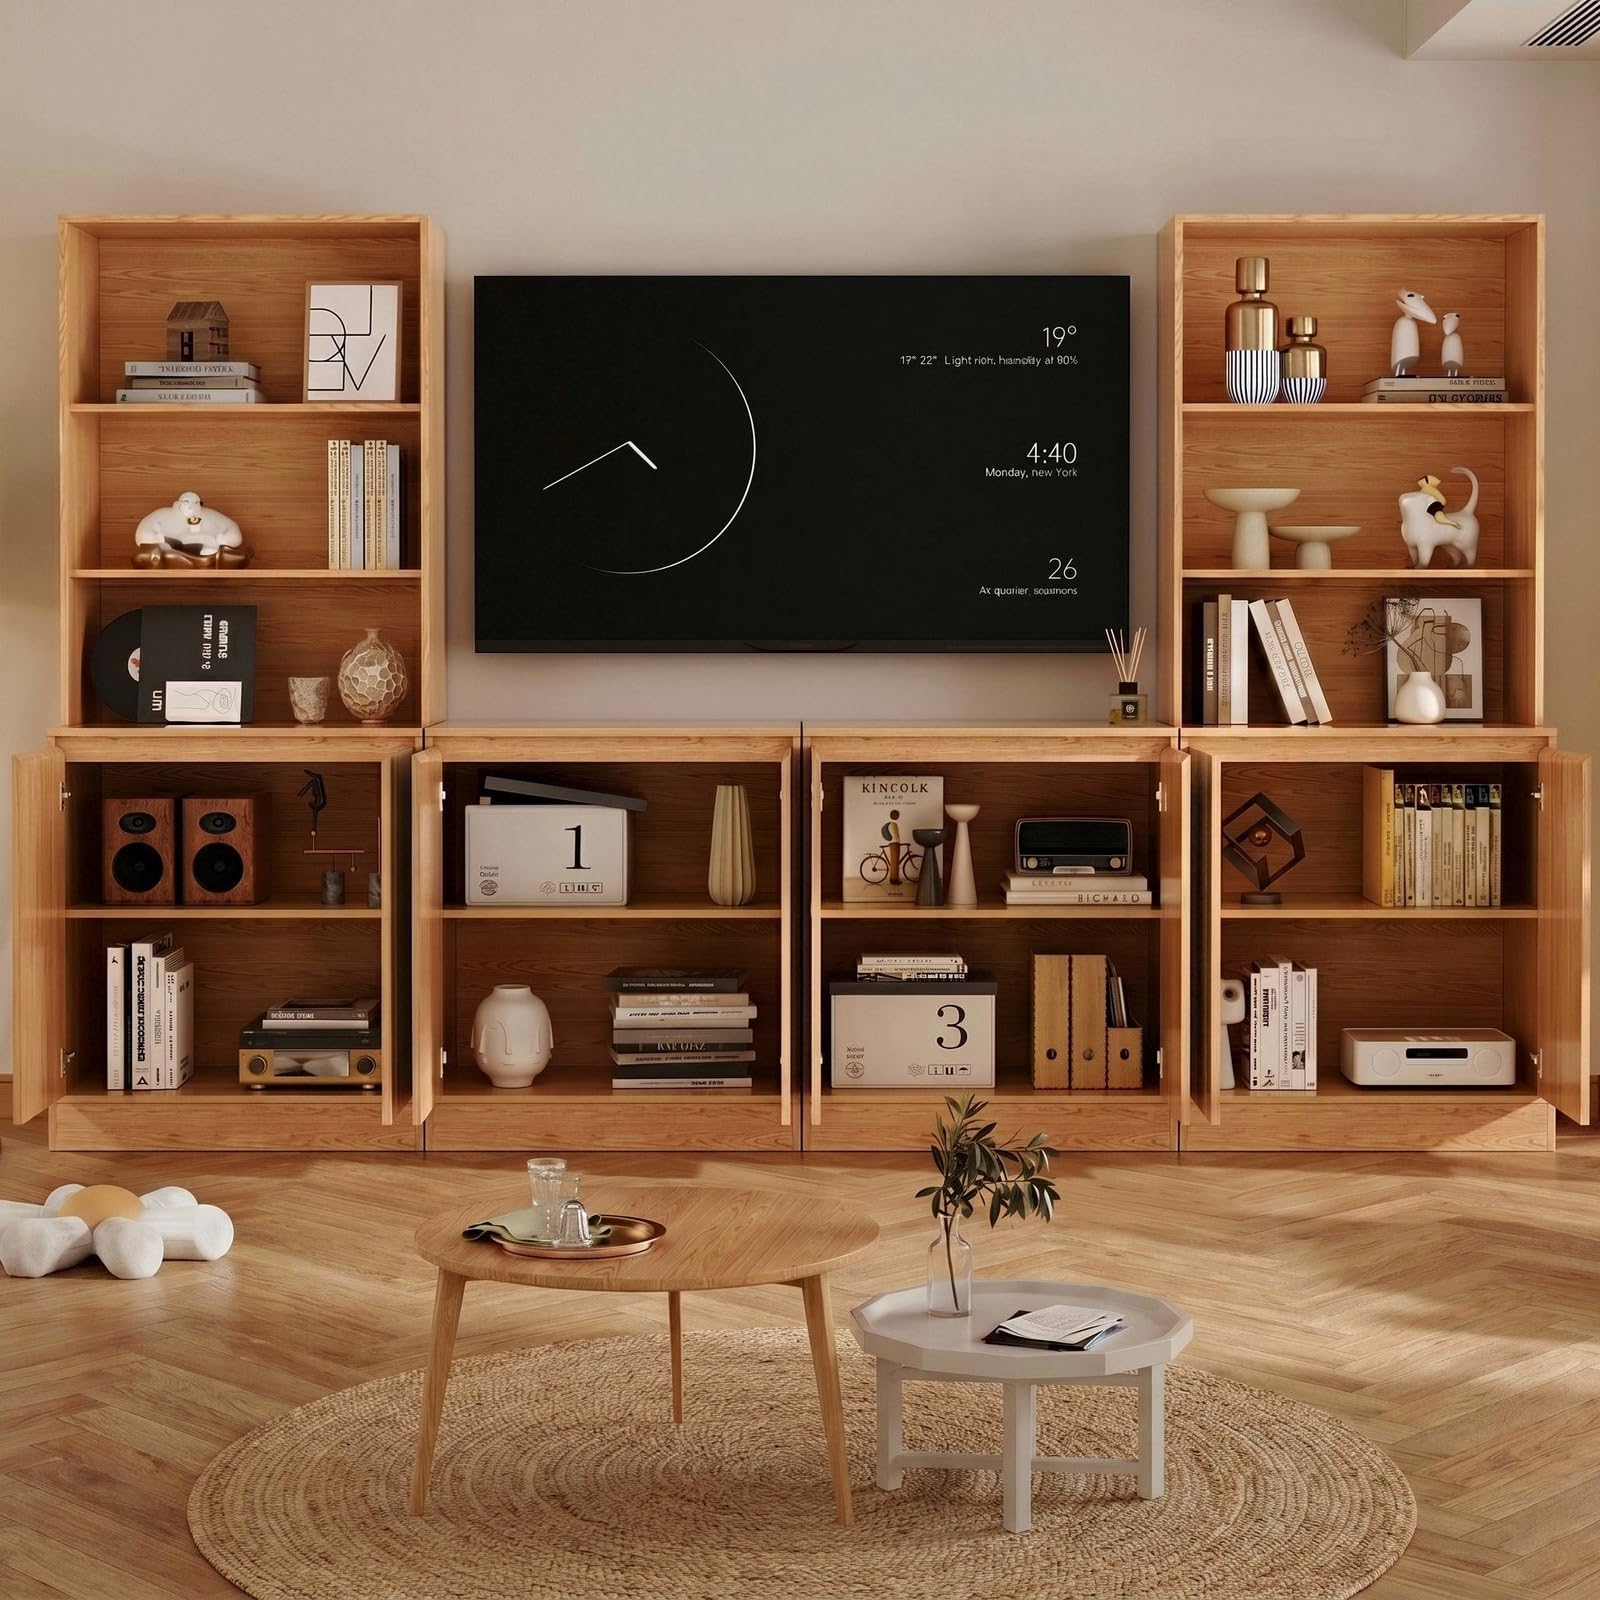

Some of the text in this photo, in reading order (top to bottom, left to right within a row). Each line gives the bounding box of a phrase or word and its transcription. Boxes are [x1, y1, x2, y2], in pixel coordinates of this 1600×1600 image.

[1042, 325, 1077, 348] 19°
[944, 355, 972, 368] Light
[1026, 442, 1077, 464] 4:40
[1031, 468, 1052, 477] new
[1056, 467, 1078, 477] York
[1048, 557, 1078, 580] 26
[862, 783, 929, 793] KINCOLK
[564, 824, 591, 870] 1
[936, 1004, 968, 1050] 3
